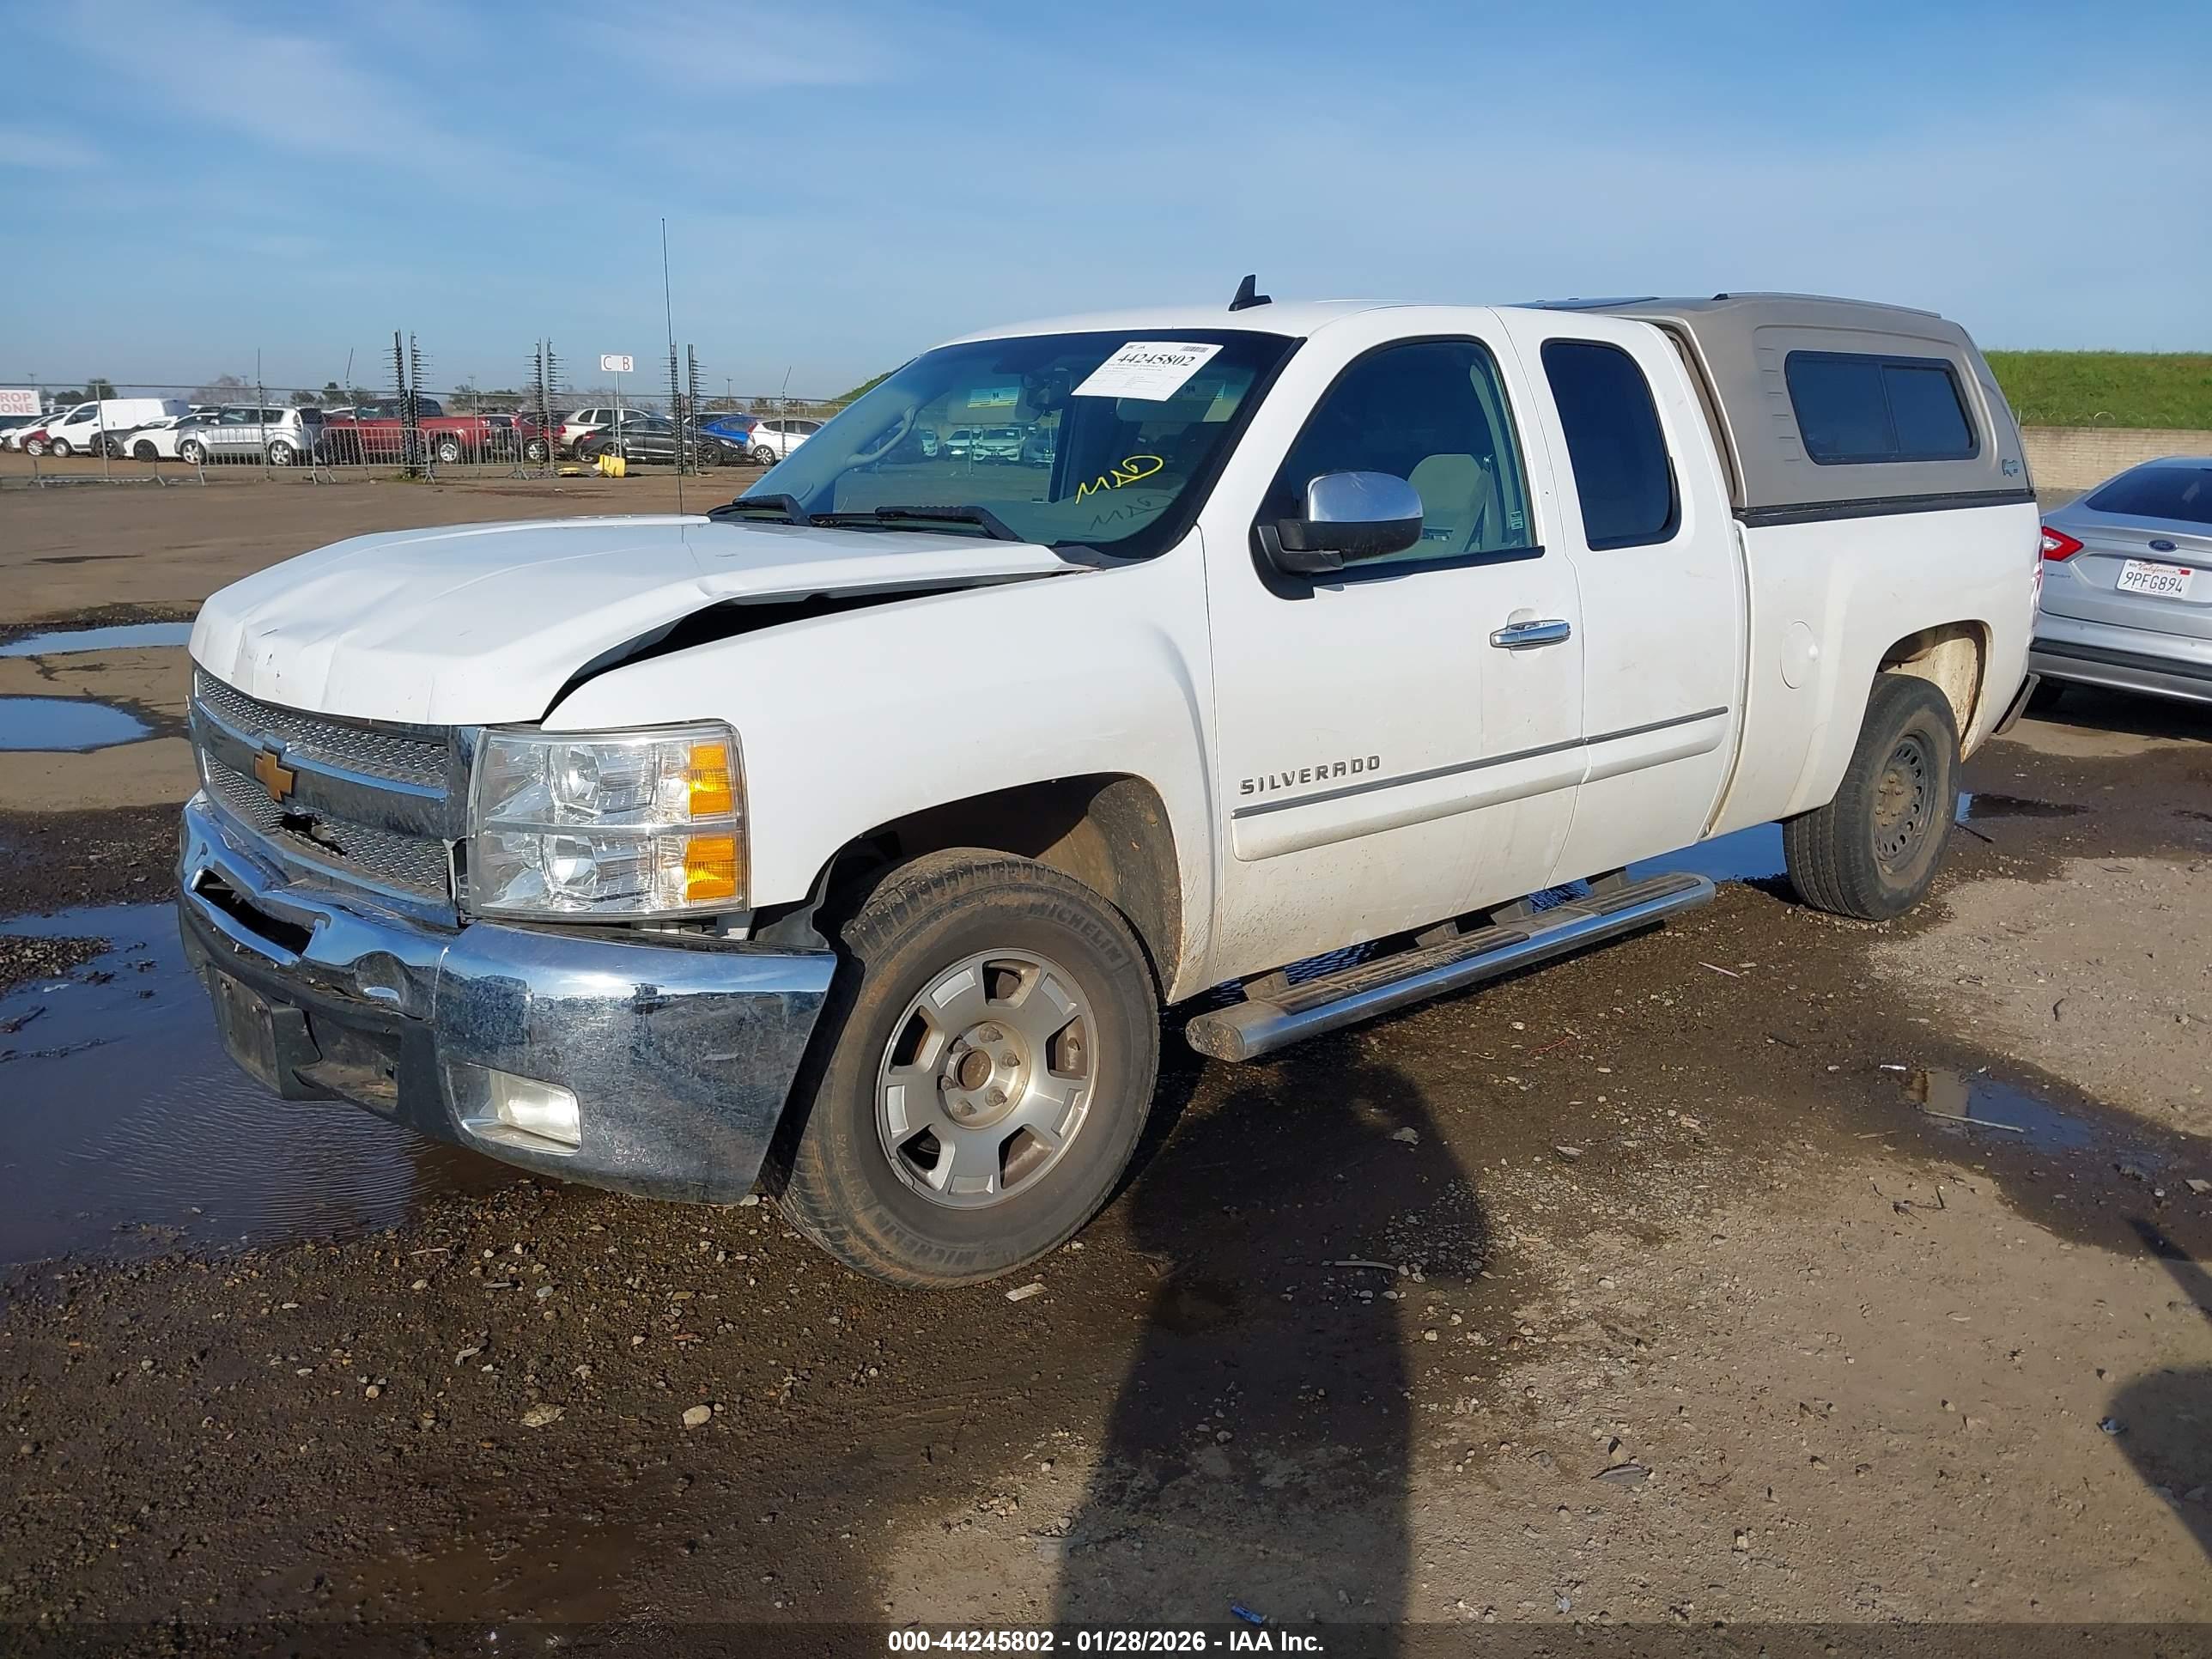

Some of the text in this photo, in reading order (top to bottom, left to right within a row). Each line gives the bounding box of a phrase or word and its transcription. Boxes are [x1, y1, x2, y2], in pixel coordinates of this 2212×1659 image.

[603, 356, 630, 371] C B
[1117, 353, 1196, 367] 44245802
[2137, 563, 2176, 574] California
[2123, 571, 2183, 592] 9PFG894
[1239, 755, 1381, 795] SILVERADO
